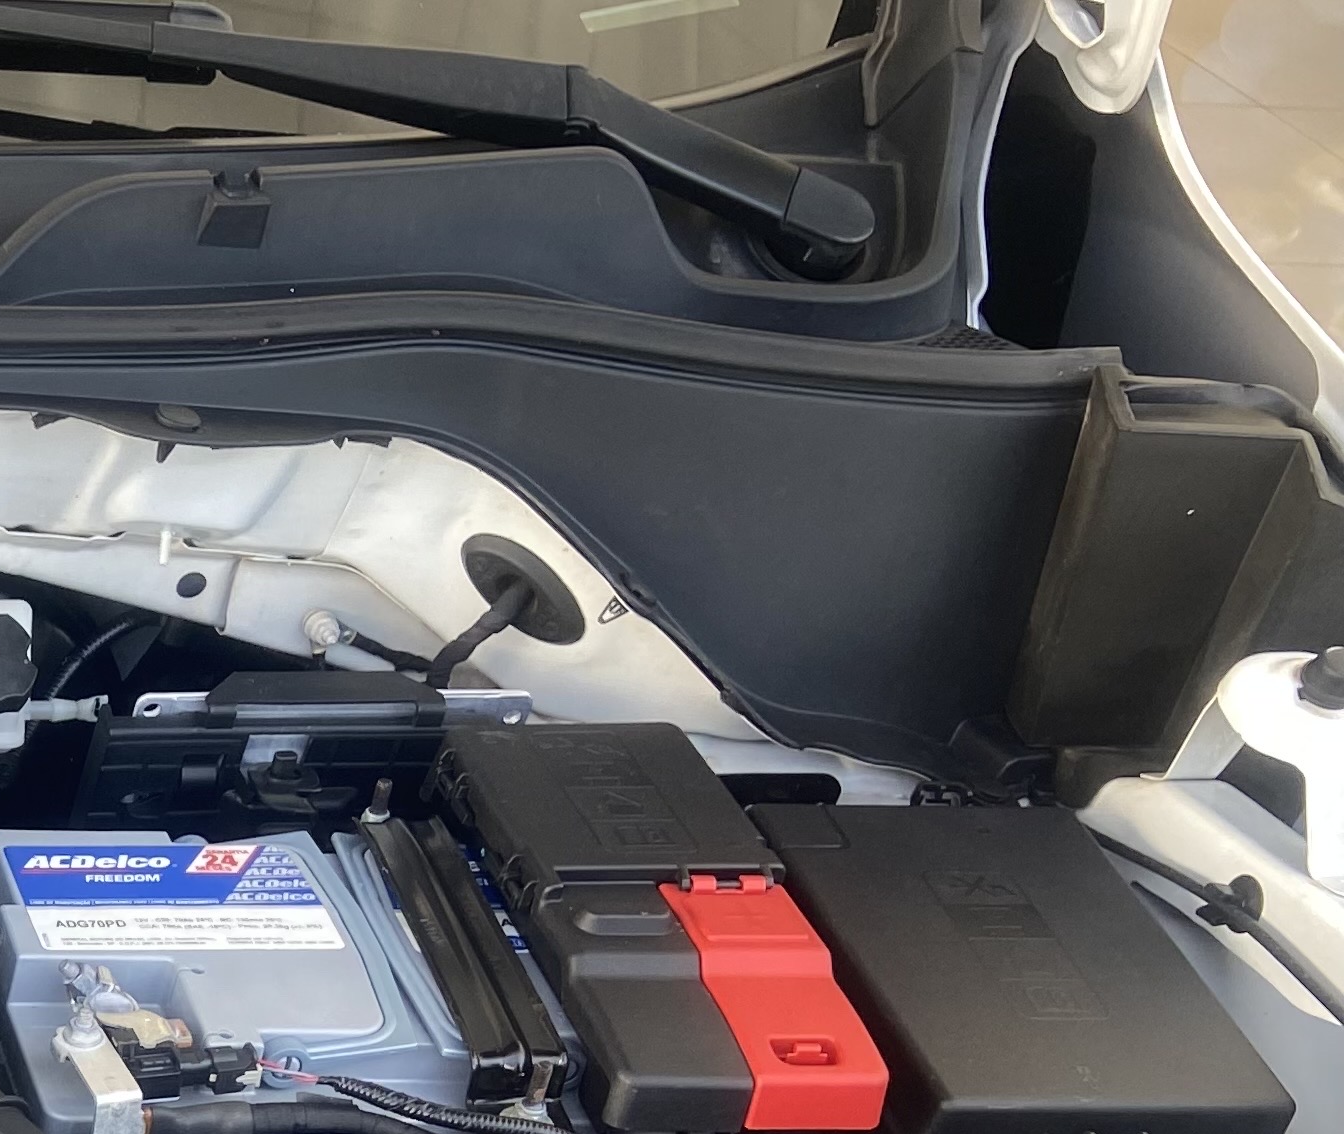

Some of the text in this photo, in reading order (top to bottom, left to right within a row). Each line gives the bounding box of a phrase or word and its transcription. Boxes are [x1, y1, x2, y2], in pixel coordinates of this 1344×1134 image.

[23, 854, 171, 869] ACDelco
[202, 855, 238, 868] 24
[85, 874, 161, 884] FREEDOM
[55, 919, 127, 928] ADG70PD
